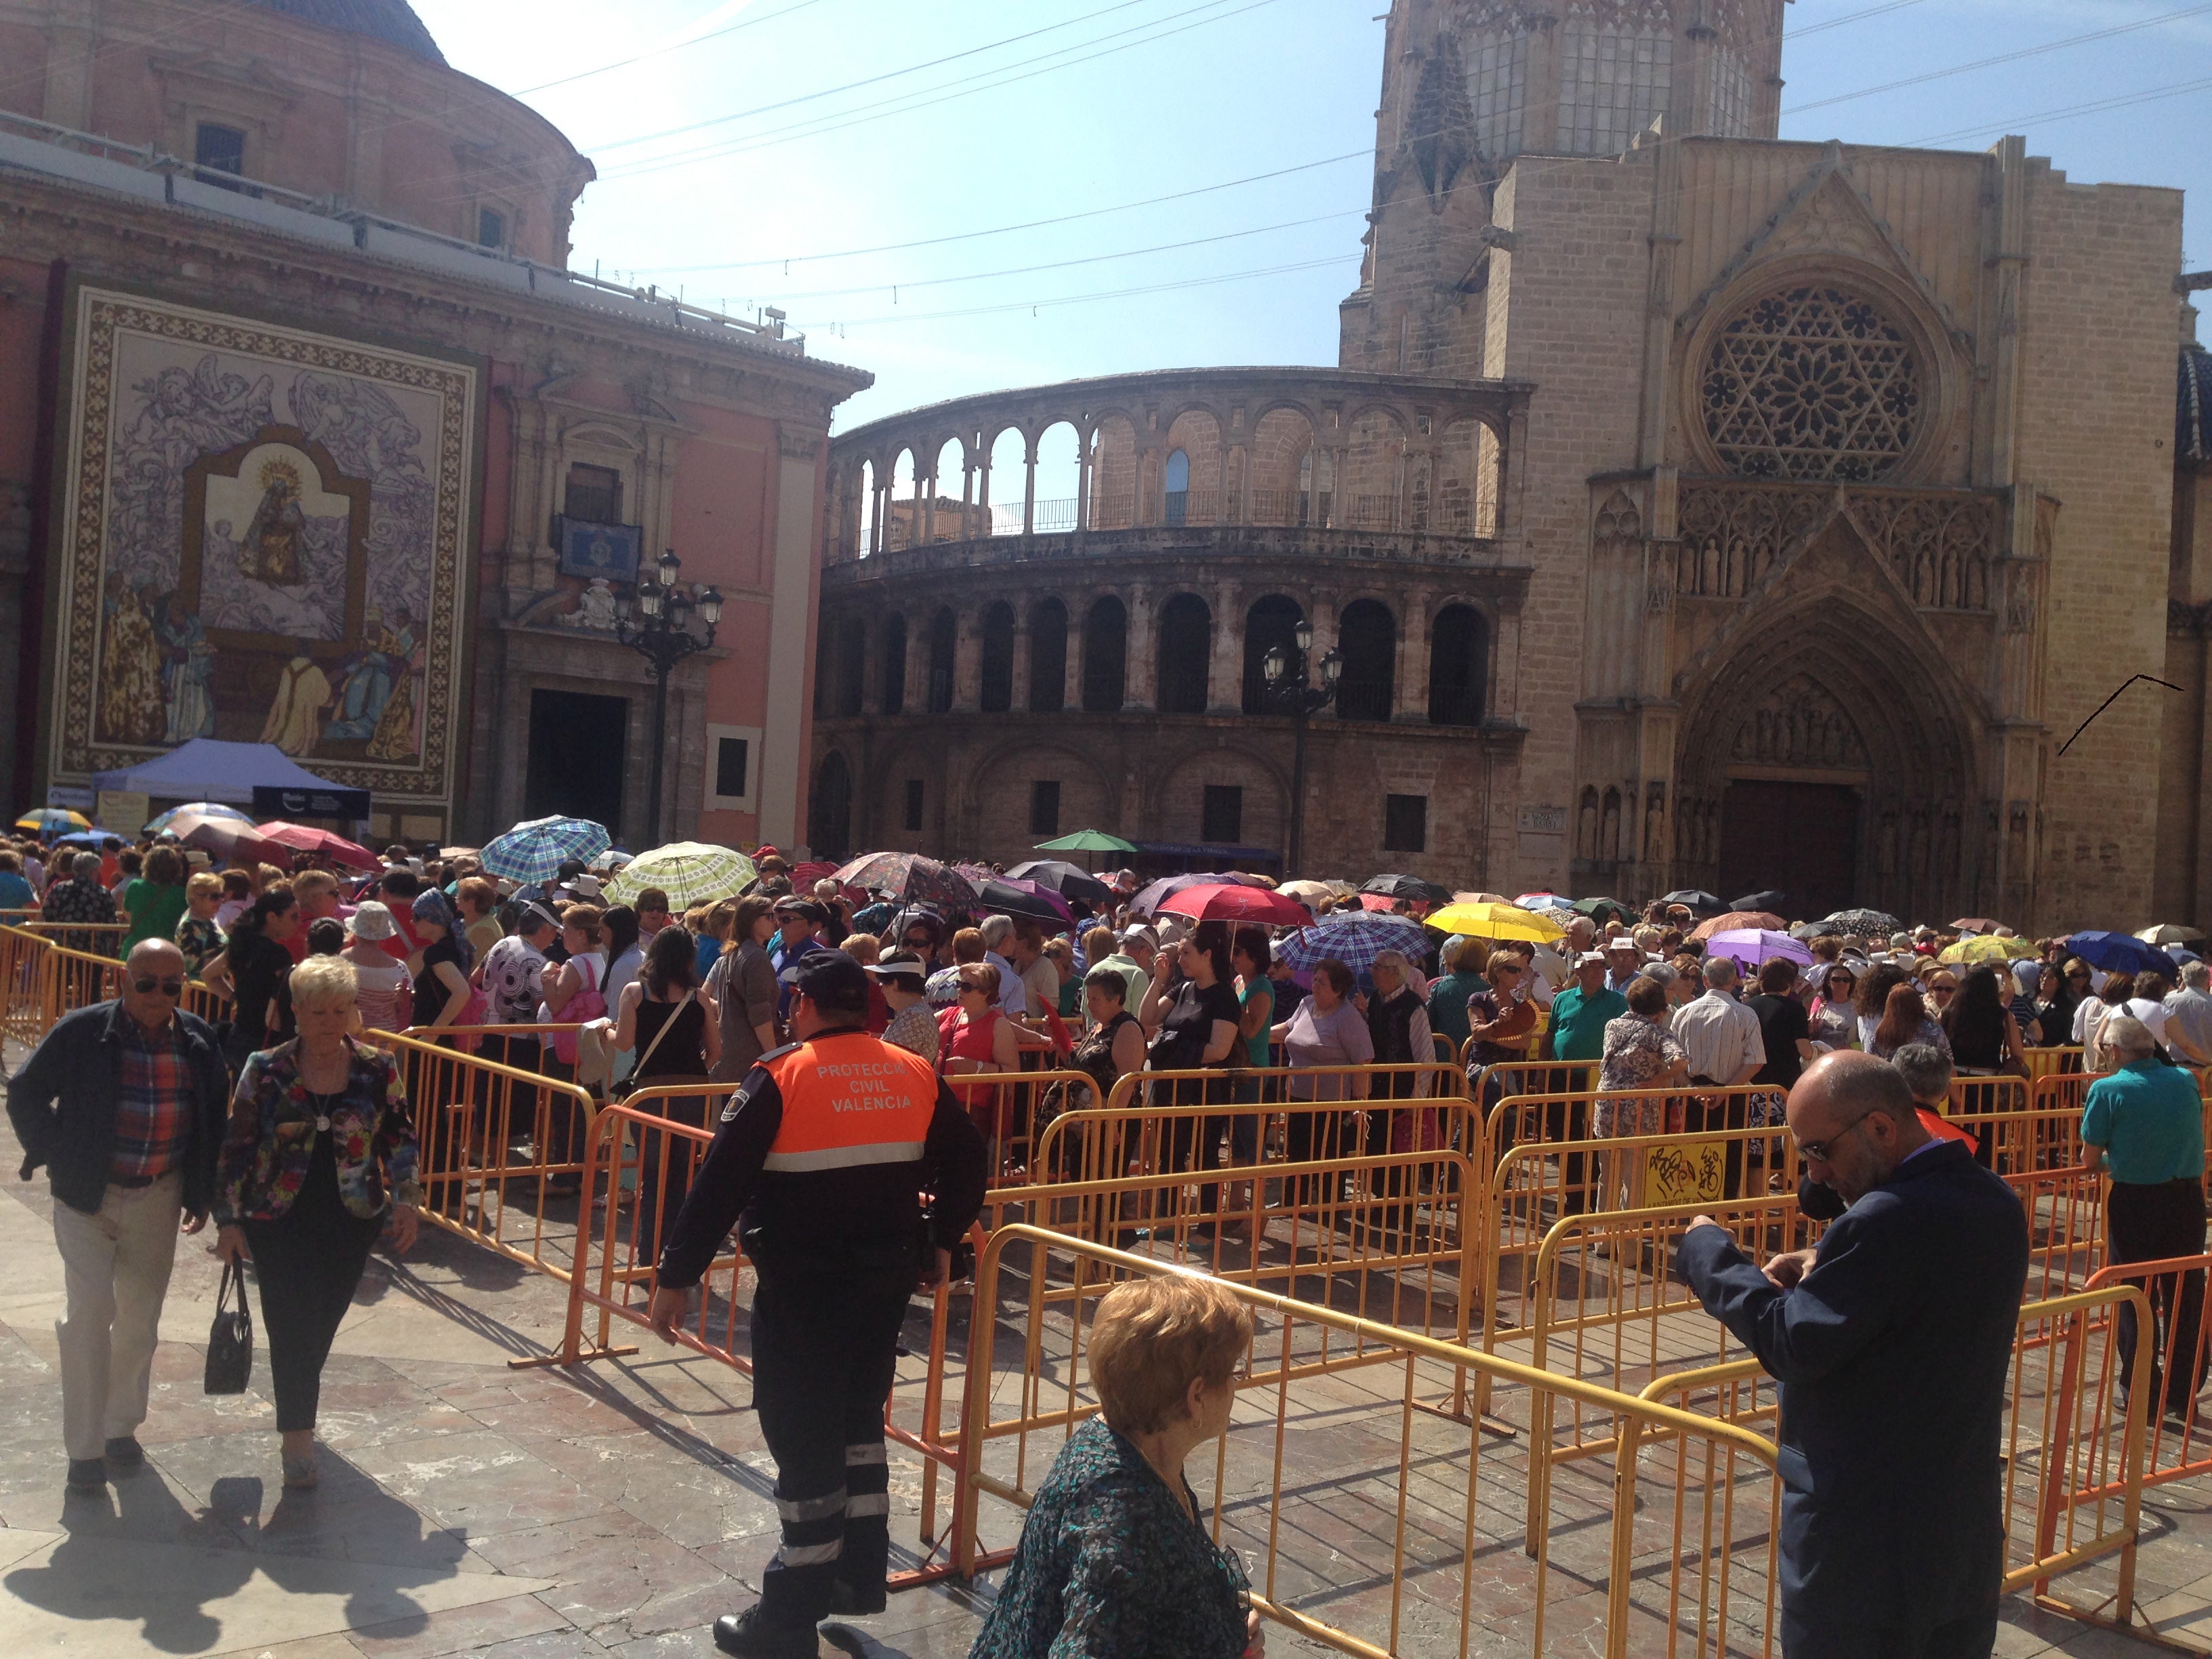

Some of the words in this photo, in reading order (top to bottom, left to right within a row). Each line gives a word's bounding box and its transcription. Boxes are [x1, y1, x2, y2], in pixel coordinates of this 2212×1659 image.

[817, 1062, 909, 1079] PROTECCI
[850, 1080, 889, 1093] CIVIL
[832, 1095, 911, 1112] VALENCIA
